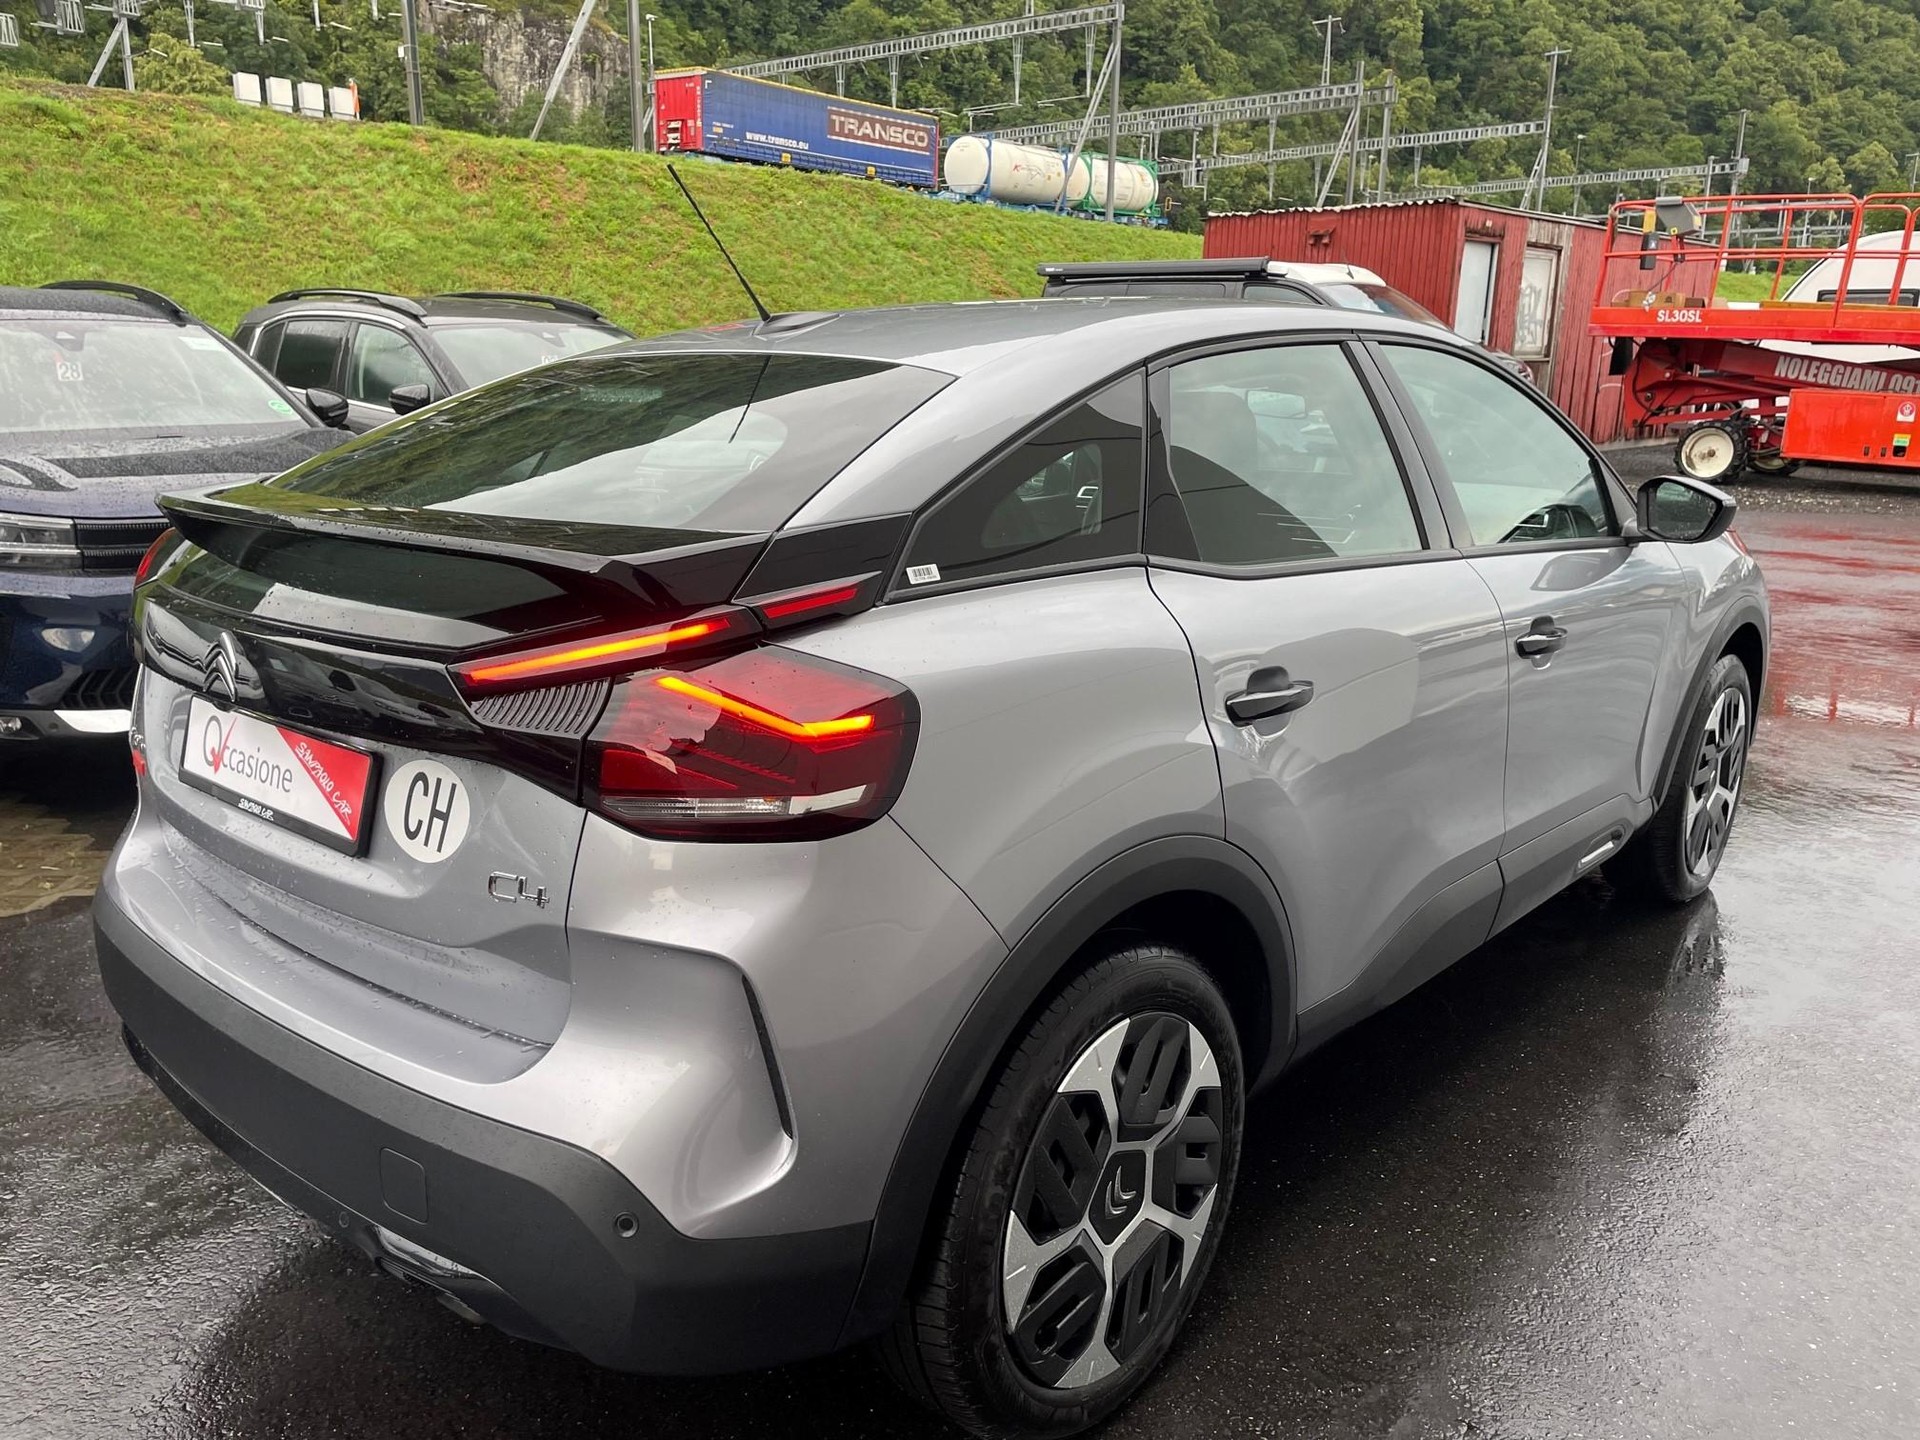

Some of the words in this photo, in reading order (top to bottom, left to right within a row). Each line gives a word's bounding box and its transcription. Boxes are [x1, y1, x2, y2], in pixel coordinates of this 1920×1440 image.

[745, 131, 809, 150] www.transco.eu
[830, 114, 929, 148] TRANSCO
[1657, 309, 1702, 323] SL30SL
[59, 362, 81, 380] 28
[1774, 355, 1888, 393] NOLEGGIAMI
[403, 771, 457, 853] CH
[488, 871, 550, 909] C4
